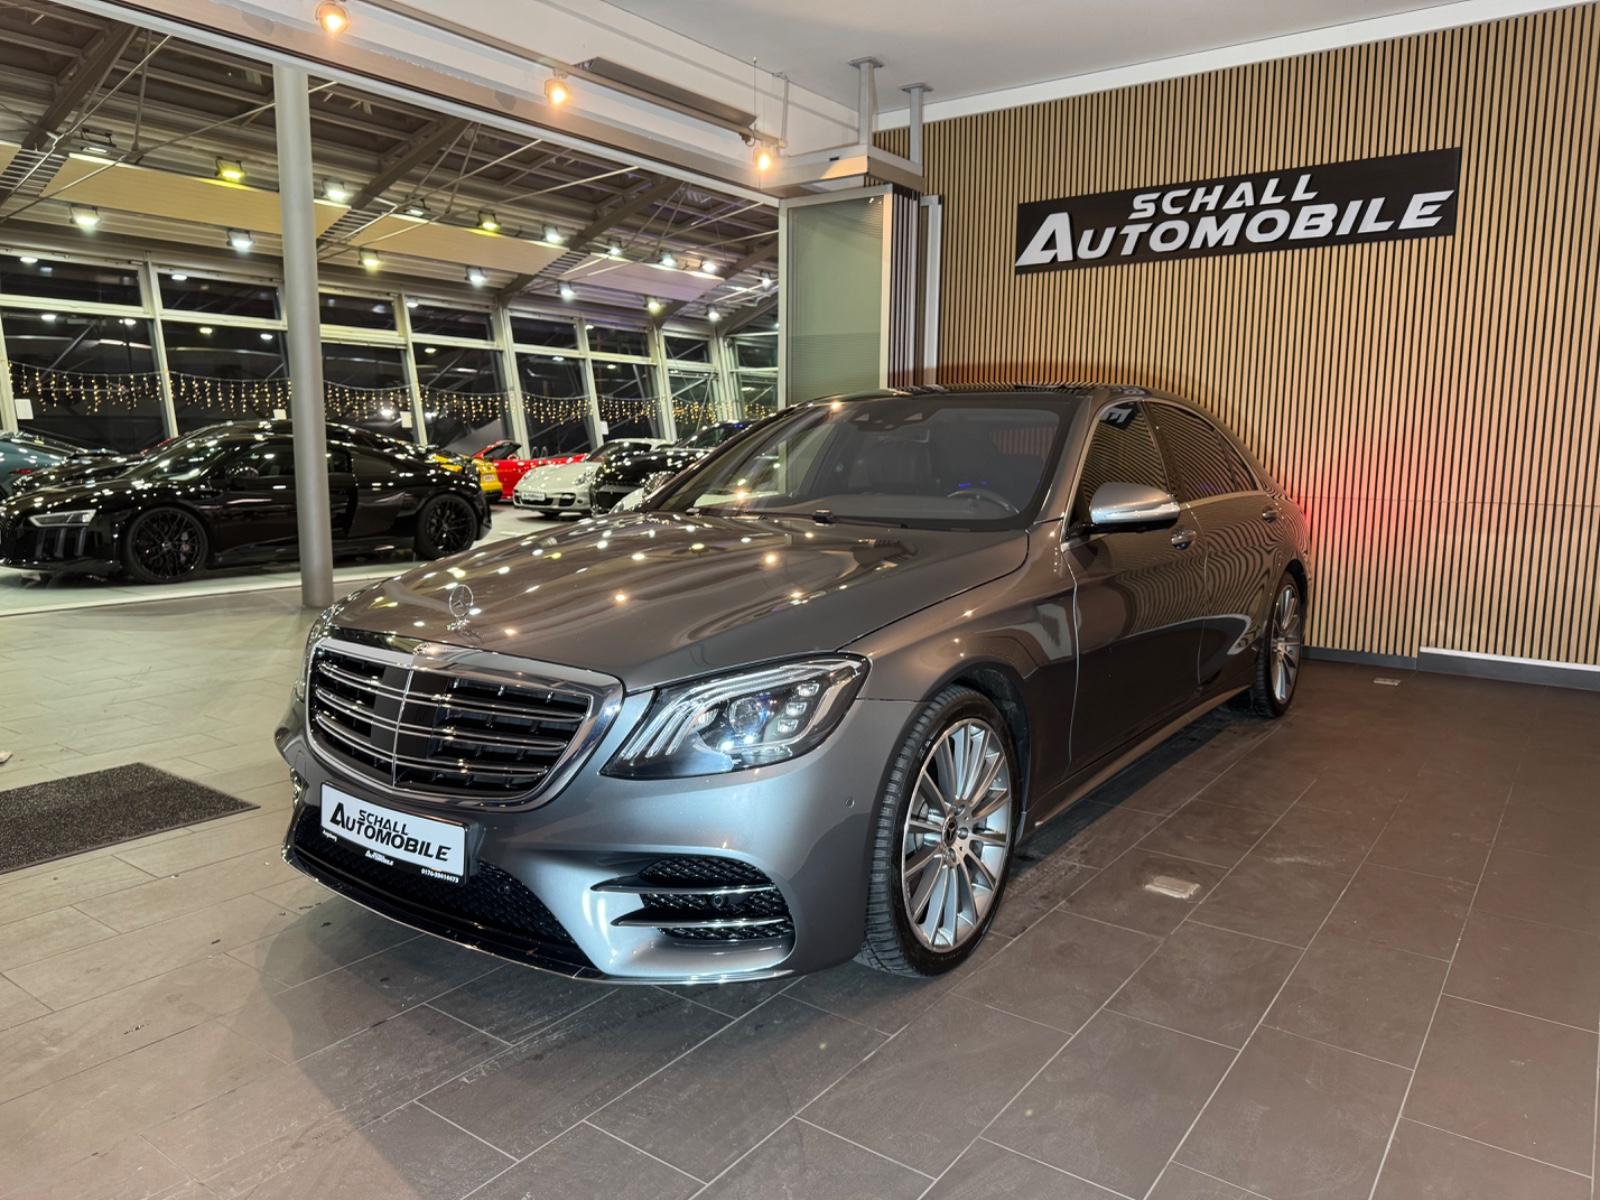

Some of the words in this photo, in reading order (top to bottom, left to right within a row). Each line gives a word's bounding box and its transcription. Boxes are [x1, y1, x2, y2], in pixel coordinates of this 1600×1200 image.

[1129, 174, 1318, 219] SCHALL
[1016, 190, 1454, 266] AUTOMOBILE
[330, 803, 451, 861] AUTOMOBILE
[359, 810, 409, 835] SCHALL
